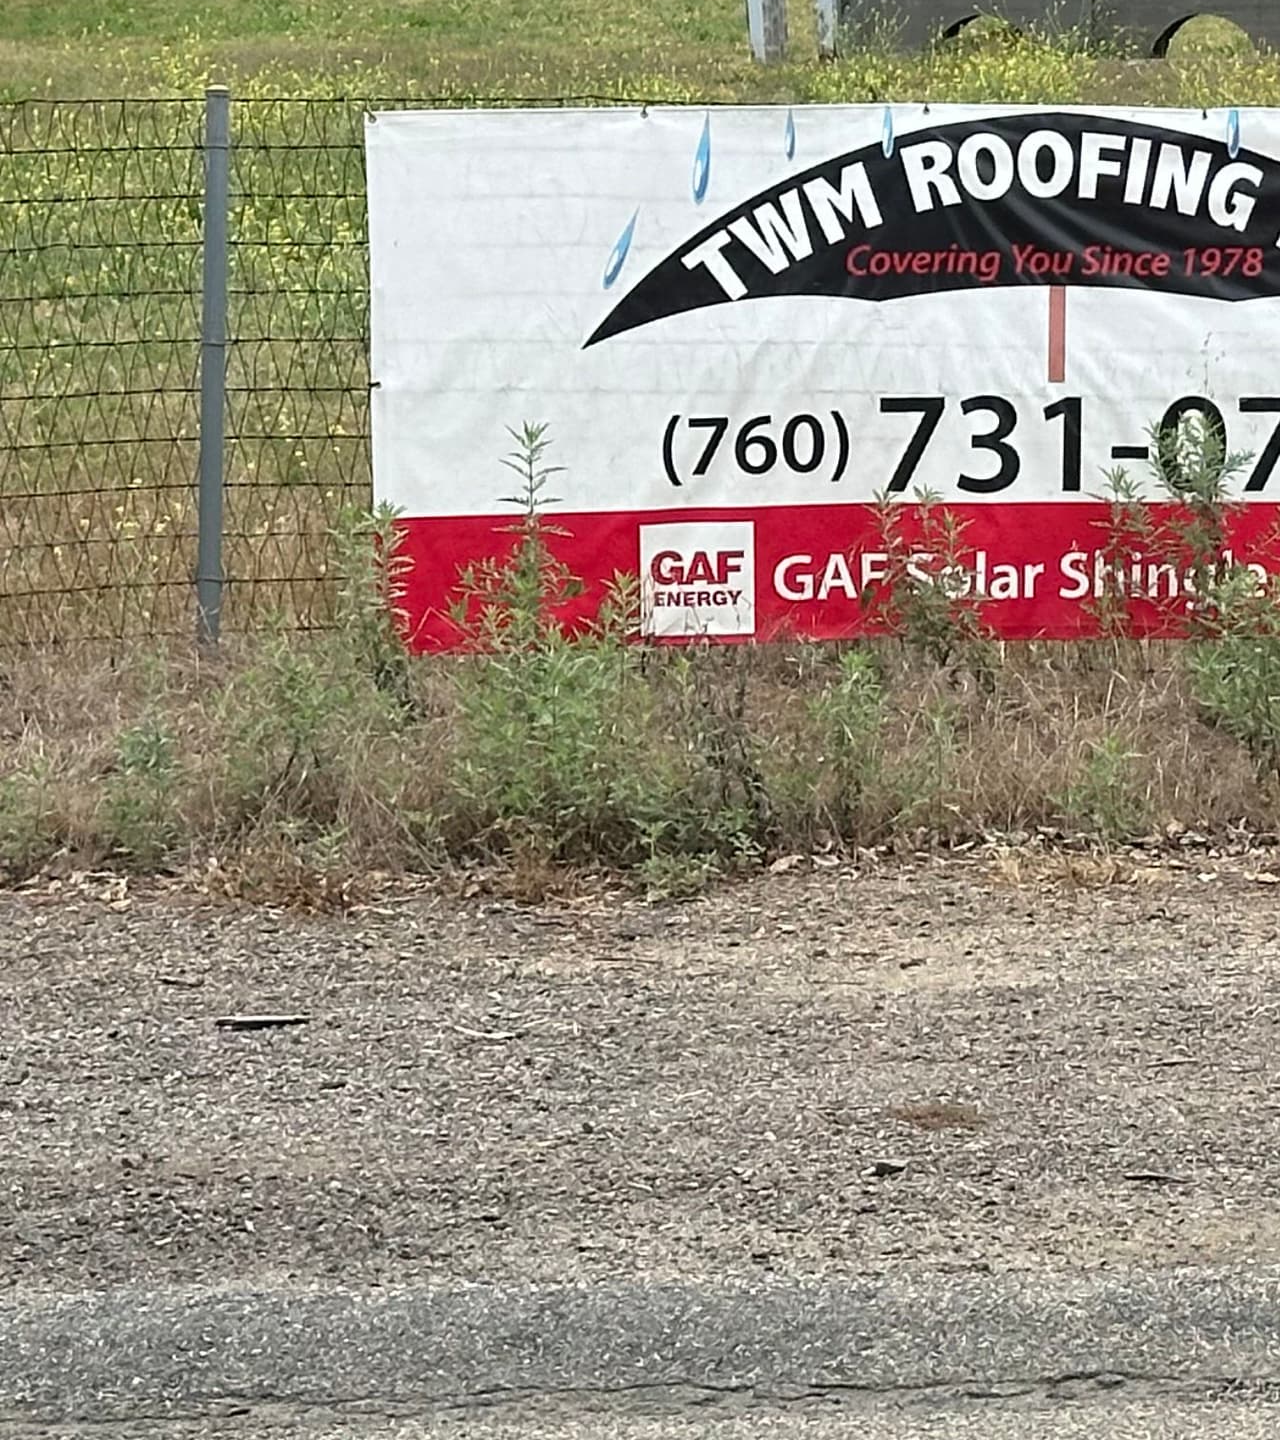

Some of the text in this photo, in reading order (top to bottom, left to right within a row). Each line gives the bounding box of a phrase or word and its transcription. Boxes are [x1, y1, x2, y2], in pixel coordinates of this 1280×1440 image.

[681, 161, 882, 301] TWM
[901, 131, 1261, 233] ROOFING
[847, 244, 1263, 282] Covering You Since 1978
[663, 411, 848, 486] (760)
[651, 550, 744, 586] GAF
[773, 553, 888, 601] GAF
[654, 590, 742, 607] ENERGY
